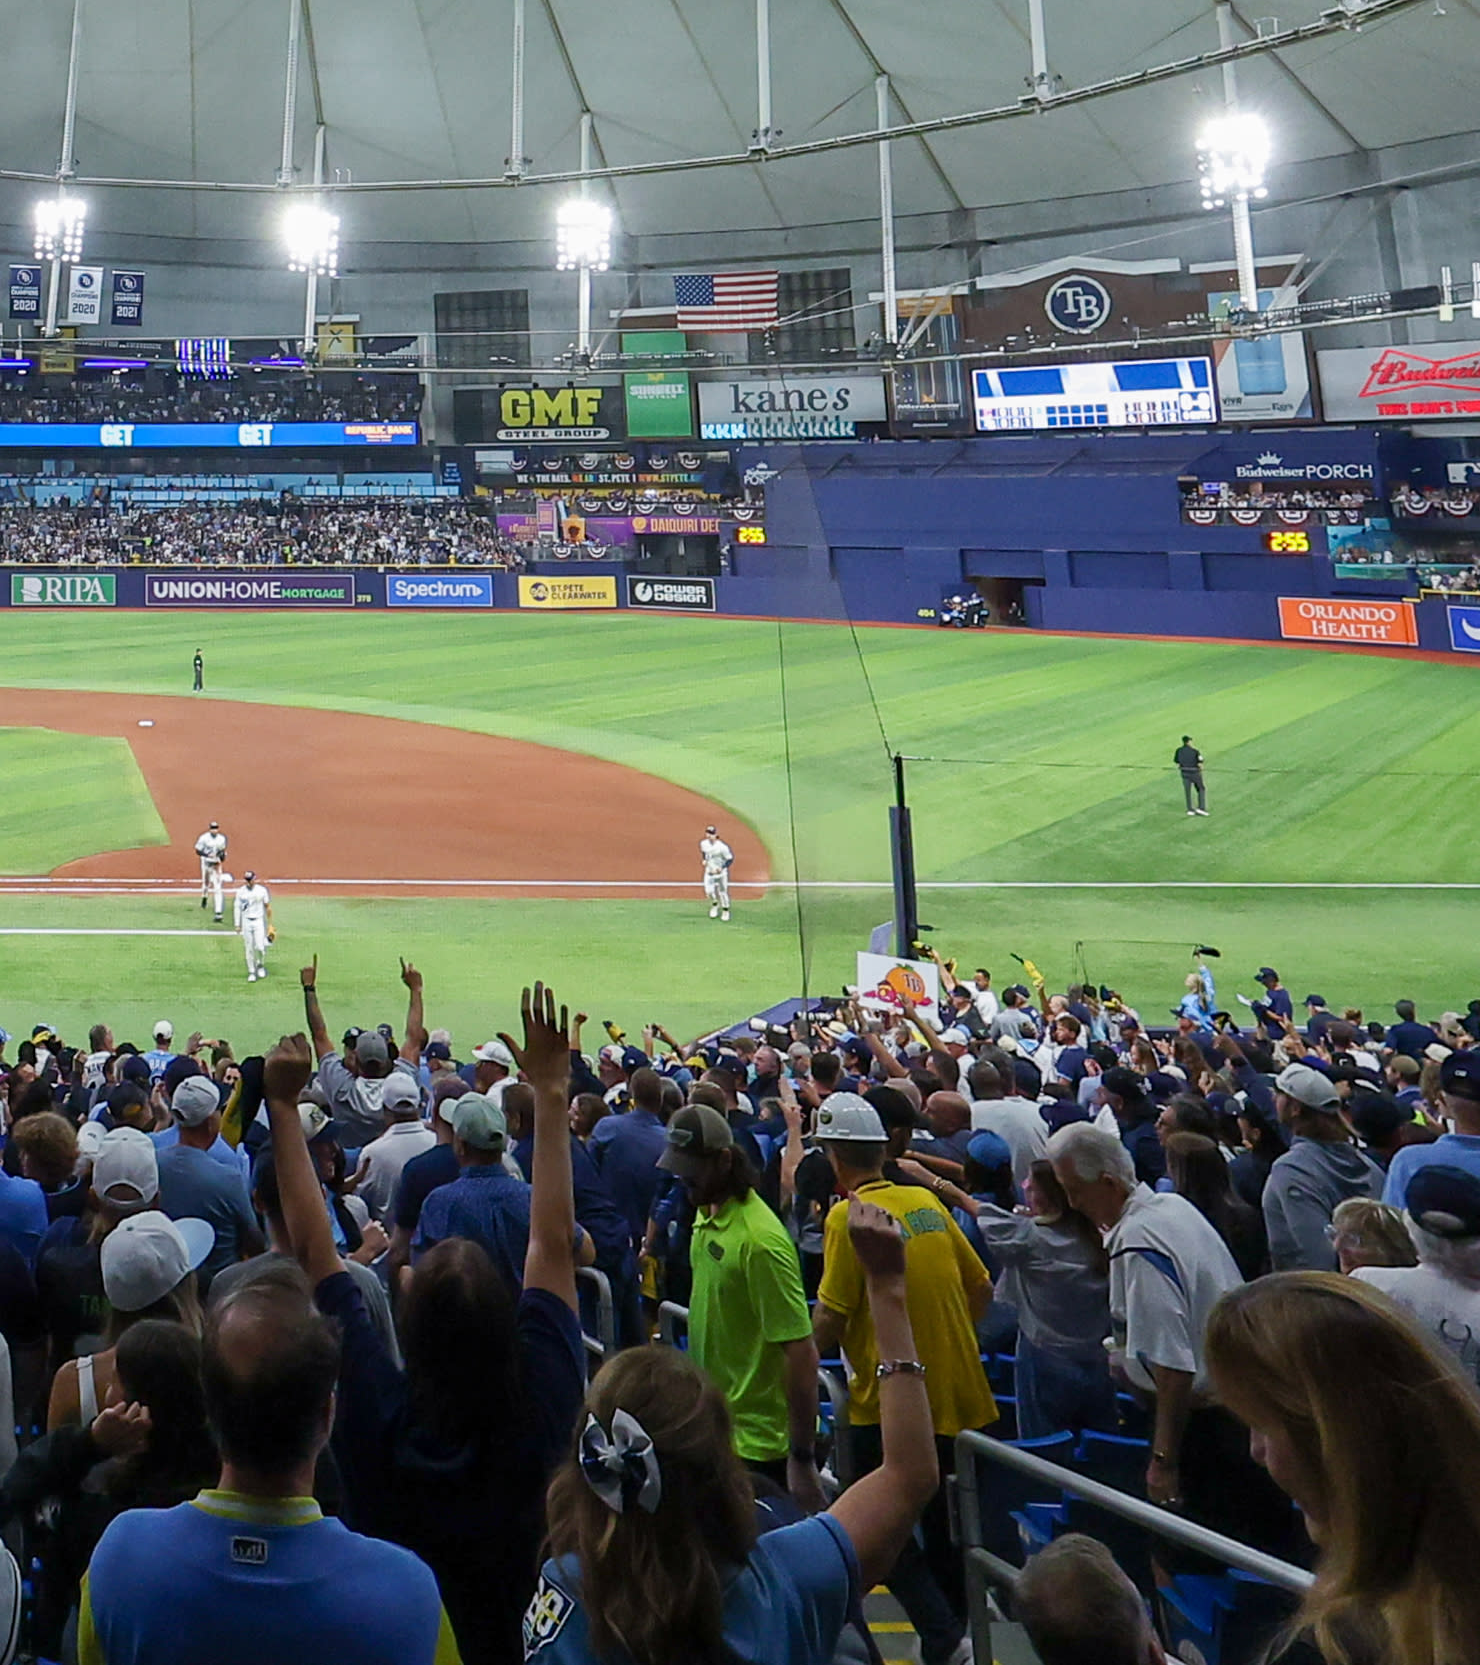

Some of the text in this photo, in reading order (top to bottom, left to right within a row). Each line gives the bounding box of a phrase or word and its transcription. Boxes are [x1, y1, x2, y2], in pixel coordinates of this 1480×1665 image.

[13, 299, 37, 311] 2020
[72, 302, 95, 314] 2020
[116, 305, 138, 317] 2021
[1056, 287, 1101, 323] TB
[500, 388, 602, 427] GMF
[729, 384, 851, 414] kane's
[100, 424, 135, 447] GET
[239, 424, 274, 447] GET
[505, 428, 601, 438] STEEL GROUP
[1236, 464, 1373, 479] Budweiser PORCH
[650, 517, 698, 533] DAIQUIRI
[44, 577, 106, 602] RIPA
[282, 588, 345, 599] MORTGAGE
[395, 580, 477, 600] Spectrum
[551, 591, 607, 601] CLEARWATER
[654, 584, 706, 594] POWER
[1298, 602, 1396, 622] ORLANDO
[1311, 620, 1388, 639] HEALTH
[904, 974, 922, 993] TB
